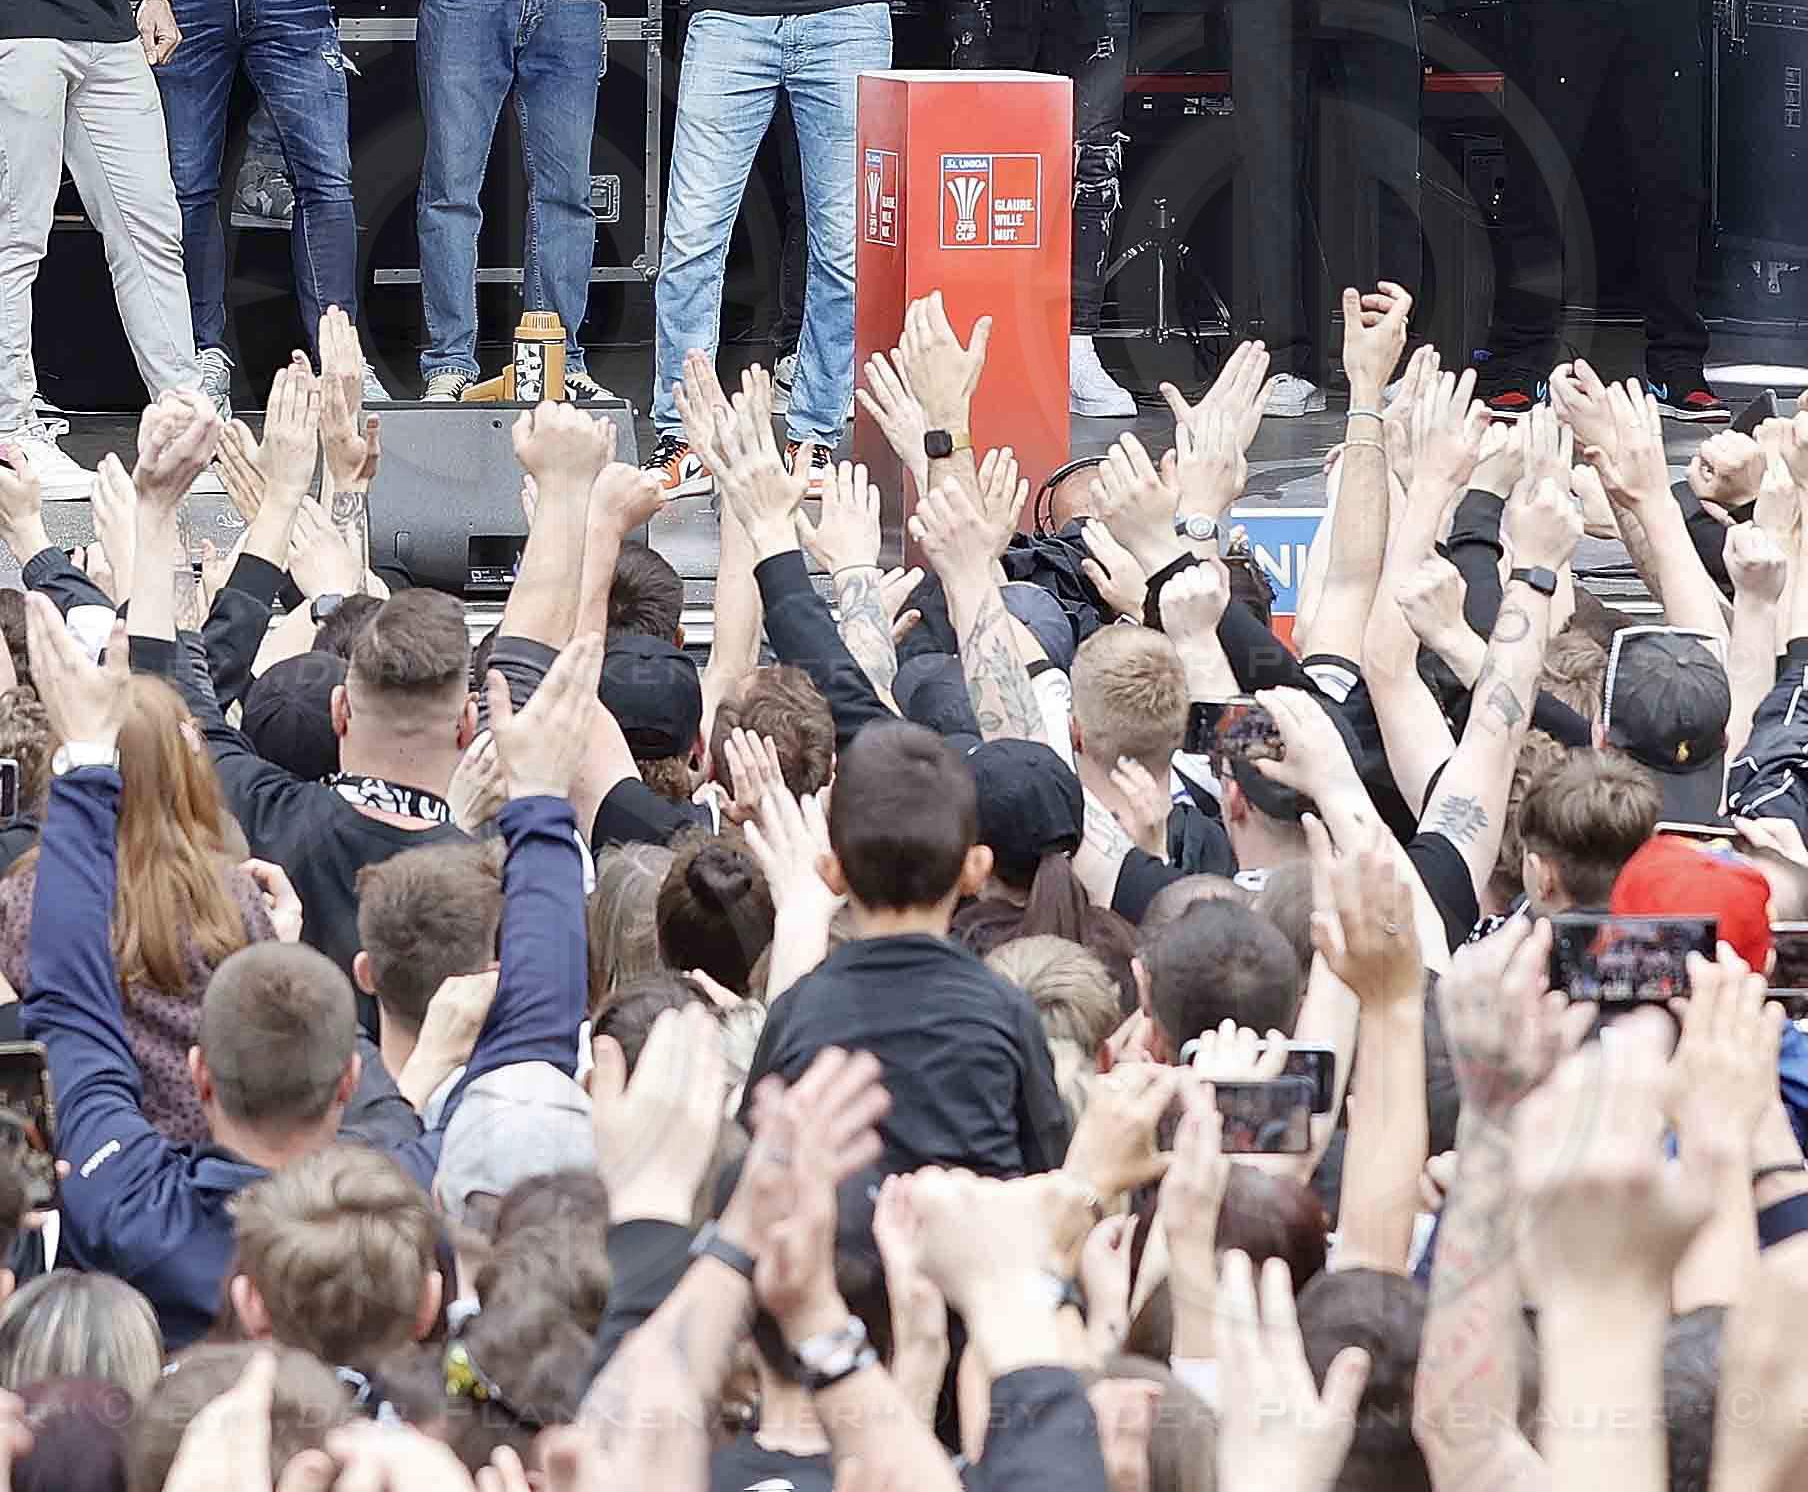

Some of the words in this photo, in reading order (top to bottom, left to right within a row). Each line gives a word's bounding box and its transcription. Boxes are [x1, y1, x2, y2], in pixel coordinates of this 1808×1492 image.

[994, 199, 1035, 212] GLAUBE.
[994, 214, 1025, 227] WILLE.
[956, 231, 977, 242] CUP
